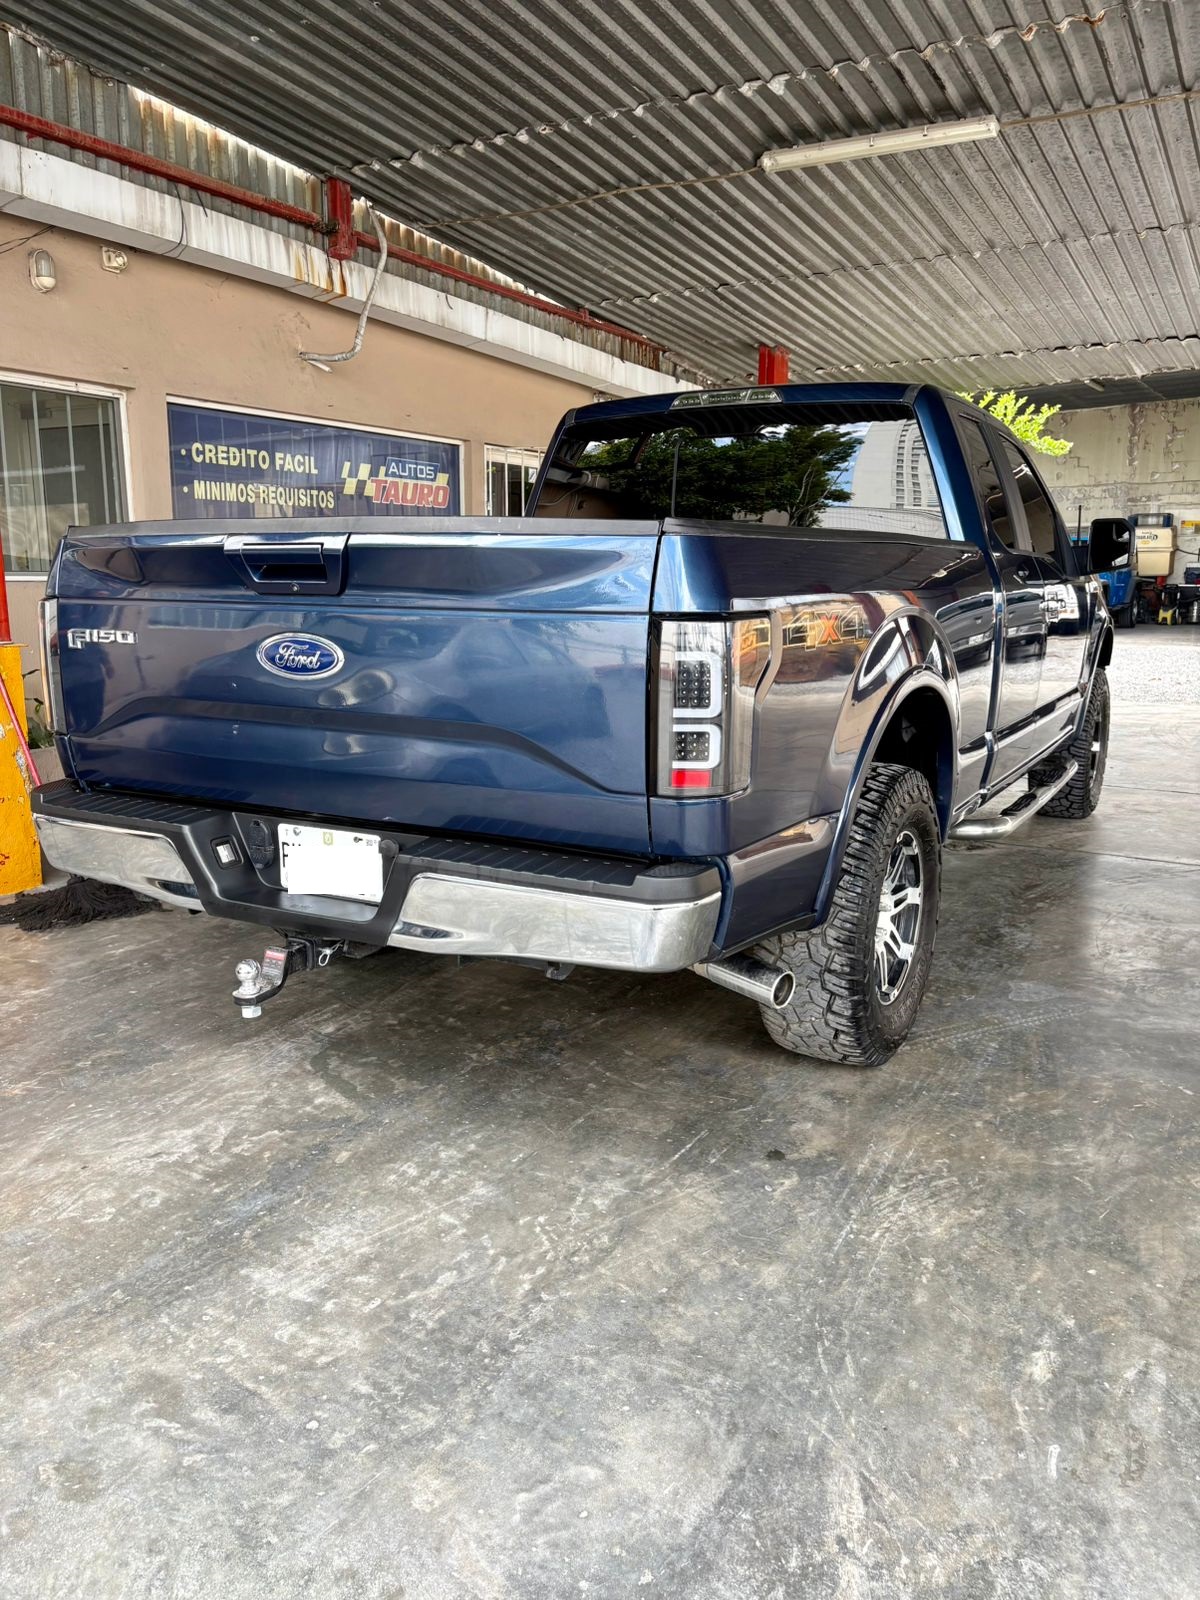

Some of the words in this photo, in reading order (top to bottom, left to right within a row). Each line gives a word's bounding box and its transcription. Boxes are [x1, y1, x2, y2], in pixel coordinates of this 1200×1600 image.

[191, 442, 270, 470] CREDITO
[275, 452, 318, 475] FACIL
[388, 461, 435, 479] AUTOS
[193, 480, 256, 504] MINIMOS
[259, 485, 335, 509] REQUISITOS
[370, 478, 450, 508] TAURO
[275, 642, 321, 670] Ford
